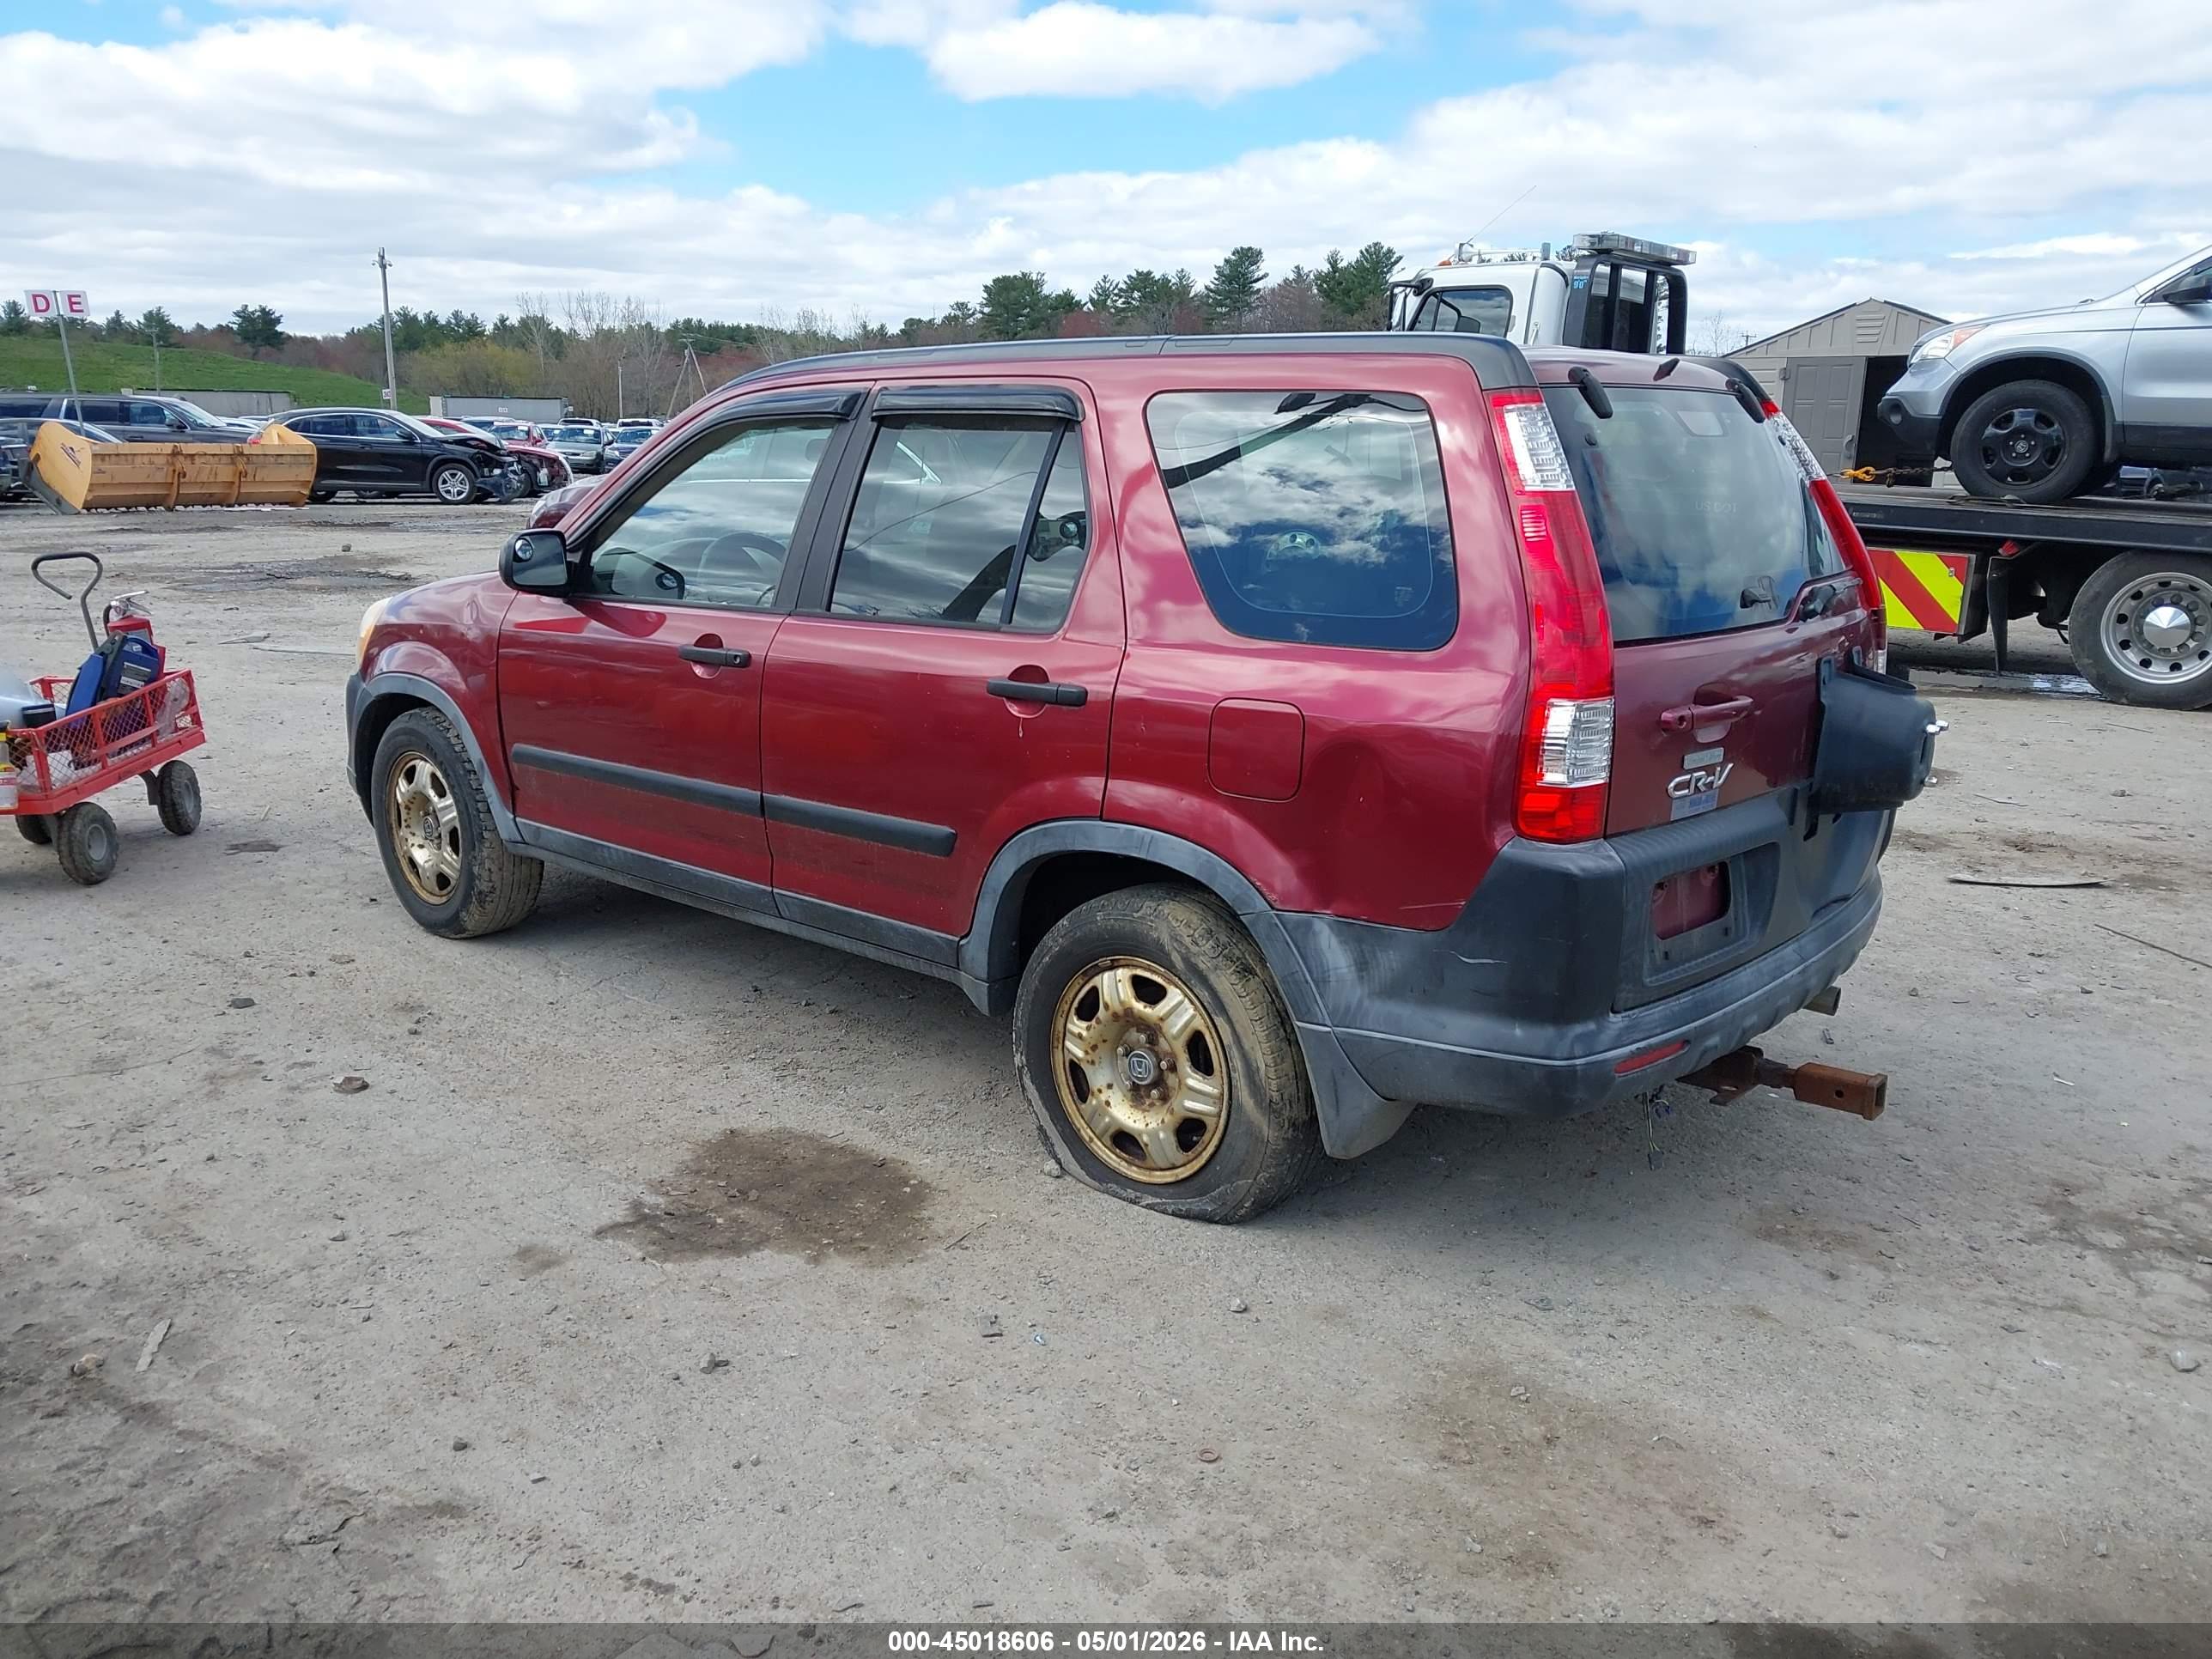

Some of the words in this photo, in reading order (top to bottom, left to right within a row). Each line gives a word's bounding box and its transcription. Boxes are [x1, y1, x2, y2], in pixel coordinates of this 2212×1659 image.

[31, 294, 51, 313] D
[67, 294, 85, 313] E
[1667, 763, 1734, 799] CR-V
